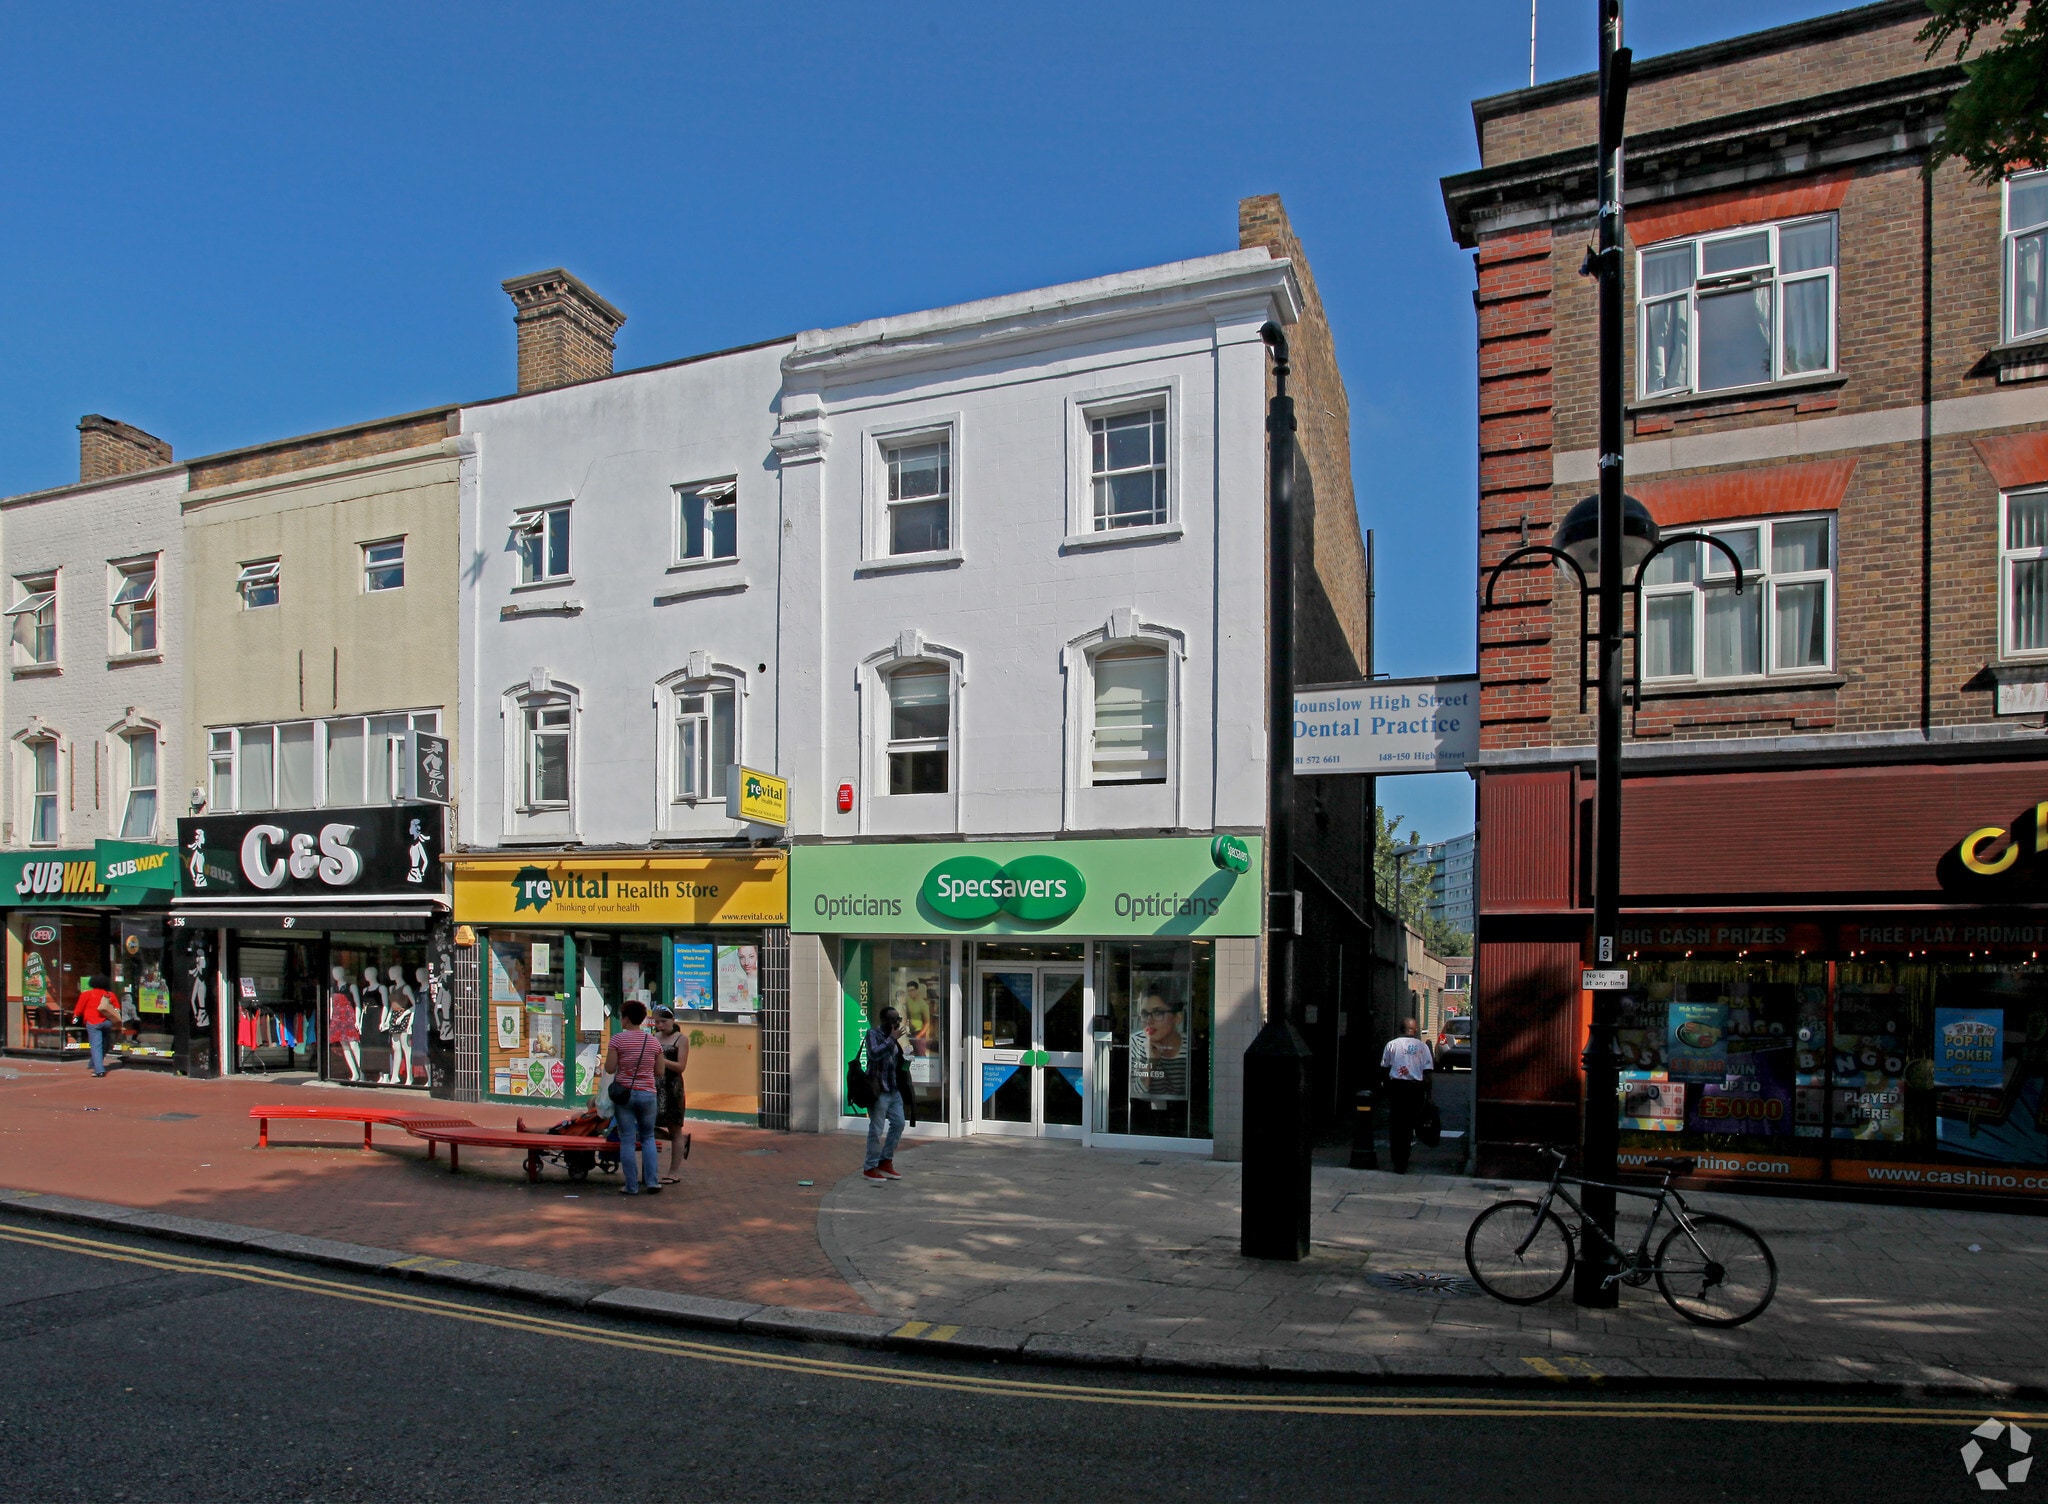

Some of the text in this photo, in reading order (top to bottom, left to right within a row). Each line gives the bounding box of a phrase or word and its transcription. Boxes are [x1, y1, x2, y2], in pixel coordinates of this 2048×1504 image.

[1369, 695, 1410, 712] High
[1417, 692, 1468, 708] Street
[1294, 715, 1460, 738] Dental Practice
[1306, 756, 1320, 764] 572
[1323, 755, 1340, 764] 6611
[1379, 751, 1465, 761] 148-150 High Street
[750, 783, 782, 800] revital
[105, 851, 170, 879] SUBWAY
[15, 861, 104, 895] SUBWA
[525, 872, 718, 899] revital Health Store
[937, 874, 1067, 902] Specsavers
[556, 902, 640, 914] Thinking of your health
[814, 893, 902, 920] Opticians
[1114, 892, 1220, 921] Opticians
[173, 917, 185, 927] 156
[721, 912, 784, 921] www.revital.co.uk
[33, 930, 52, 940] OPEN
[1620, 928, 1786, 945] BIG CASH PRIZES
[1859, 927, 1904, 943] FREE
[1910, 926, 1957, 943] PLAY
[1602, 938, 1609, 948] 2
[1602, 950, 1609, 960] 9
[858, 980, 868, 1023] Lenses
[1634, 1001, 1669, 1012] PLAYE
[1640, 1016, 1665, 1026] HER
[1944, 1034, 1994, 1047] POP-IN
[1945, 1048, 1993, 1062] POKER
[1727, 1064, 1756, 1075] WIN
[1800, 1051, 1903, 1077] BNGO
[1719, 1081, 1761, 1092] UP TO
[1844, 1092, 1898, 1104] PLAYED
[1698, 1095, 1784, 1121] £5000
[1851, 1108, 1891, 1119] HERE
